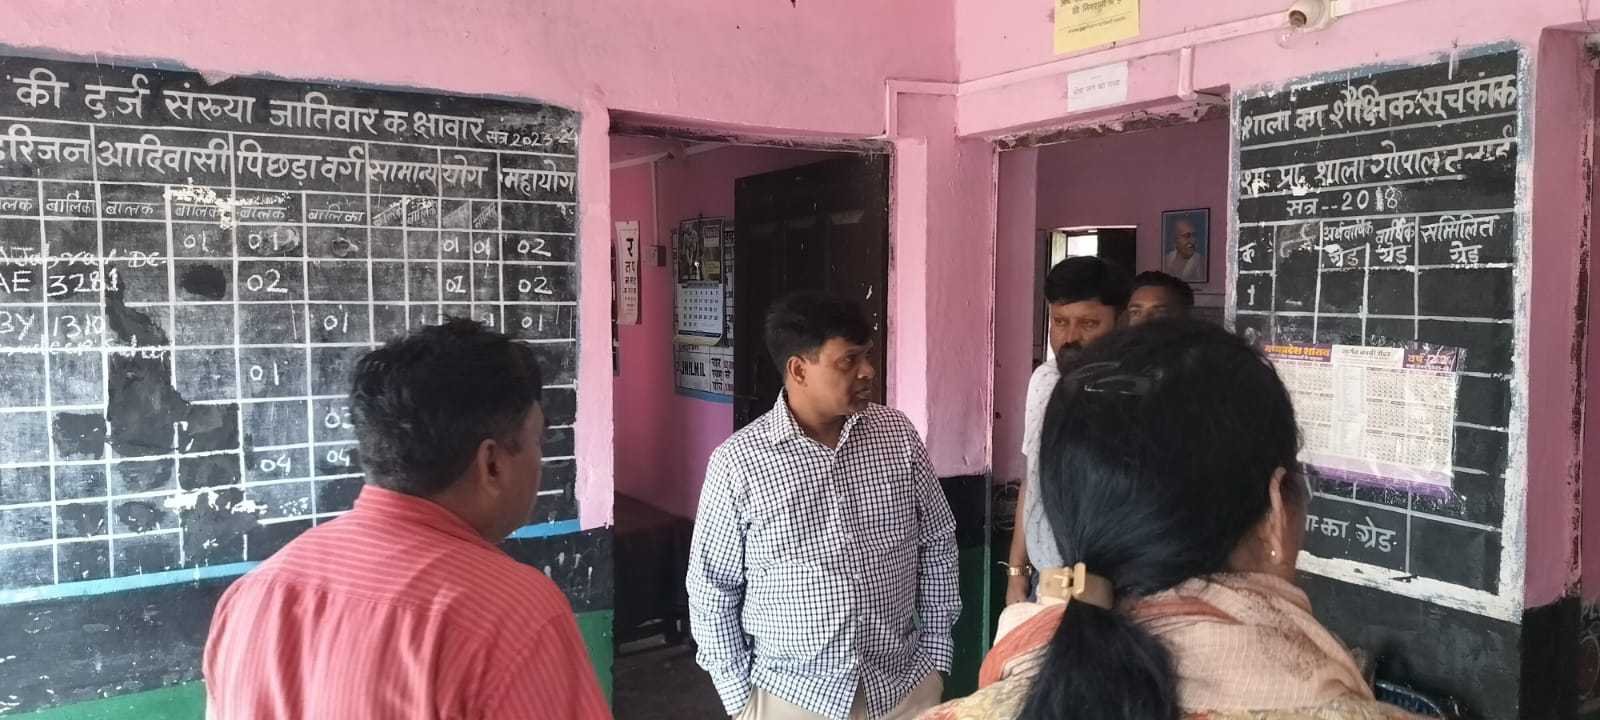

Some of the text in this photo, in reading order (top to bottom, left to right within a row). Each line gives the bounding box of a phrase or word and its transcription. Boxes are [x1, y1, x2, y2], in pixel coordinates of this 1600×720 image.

[13, 67, 69, 109] की
[84, 73, 150, 119] दर्ज
[162, 82, 256, 124] संख्या
[269, 92, 378, 135] जातिवार
[1241, 110, 1290, 140] शाला
[1295, 104, 1329, 131] का
[97, 134, 231, 175] आदिवासी
[320, 146, 364, 182] वर्ग
[369, 159, 440, 185] सामान्य
[442, 155, 489, 189] योग
[500, 160, 577, 195] महायोग
[1286, 198, 1319, 216] सत्र
[443, 237, 459, 253] 01
[517, 237, 551, 257] 02
[247, 268, 288, 293] 02
[518, 277, 552, 294] 02
[323, 312, 348, 333] 01
[521, 313, 543, 332] 01
[250, 361, 279, 386] 01
[260, 455, 291, 473] 04
[326, 448, 350, 466] 04
